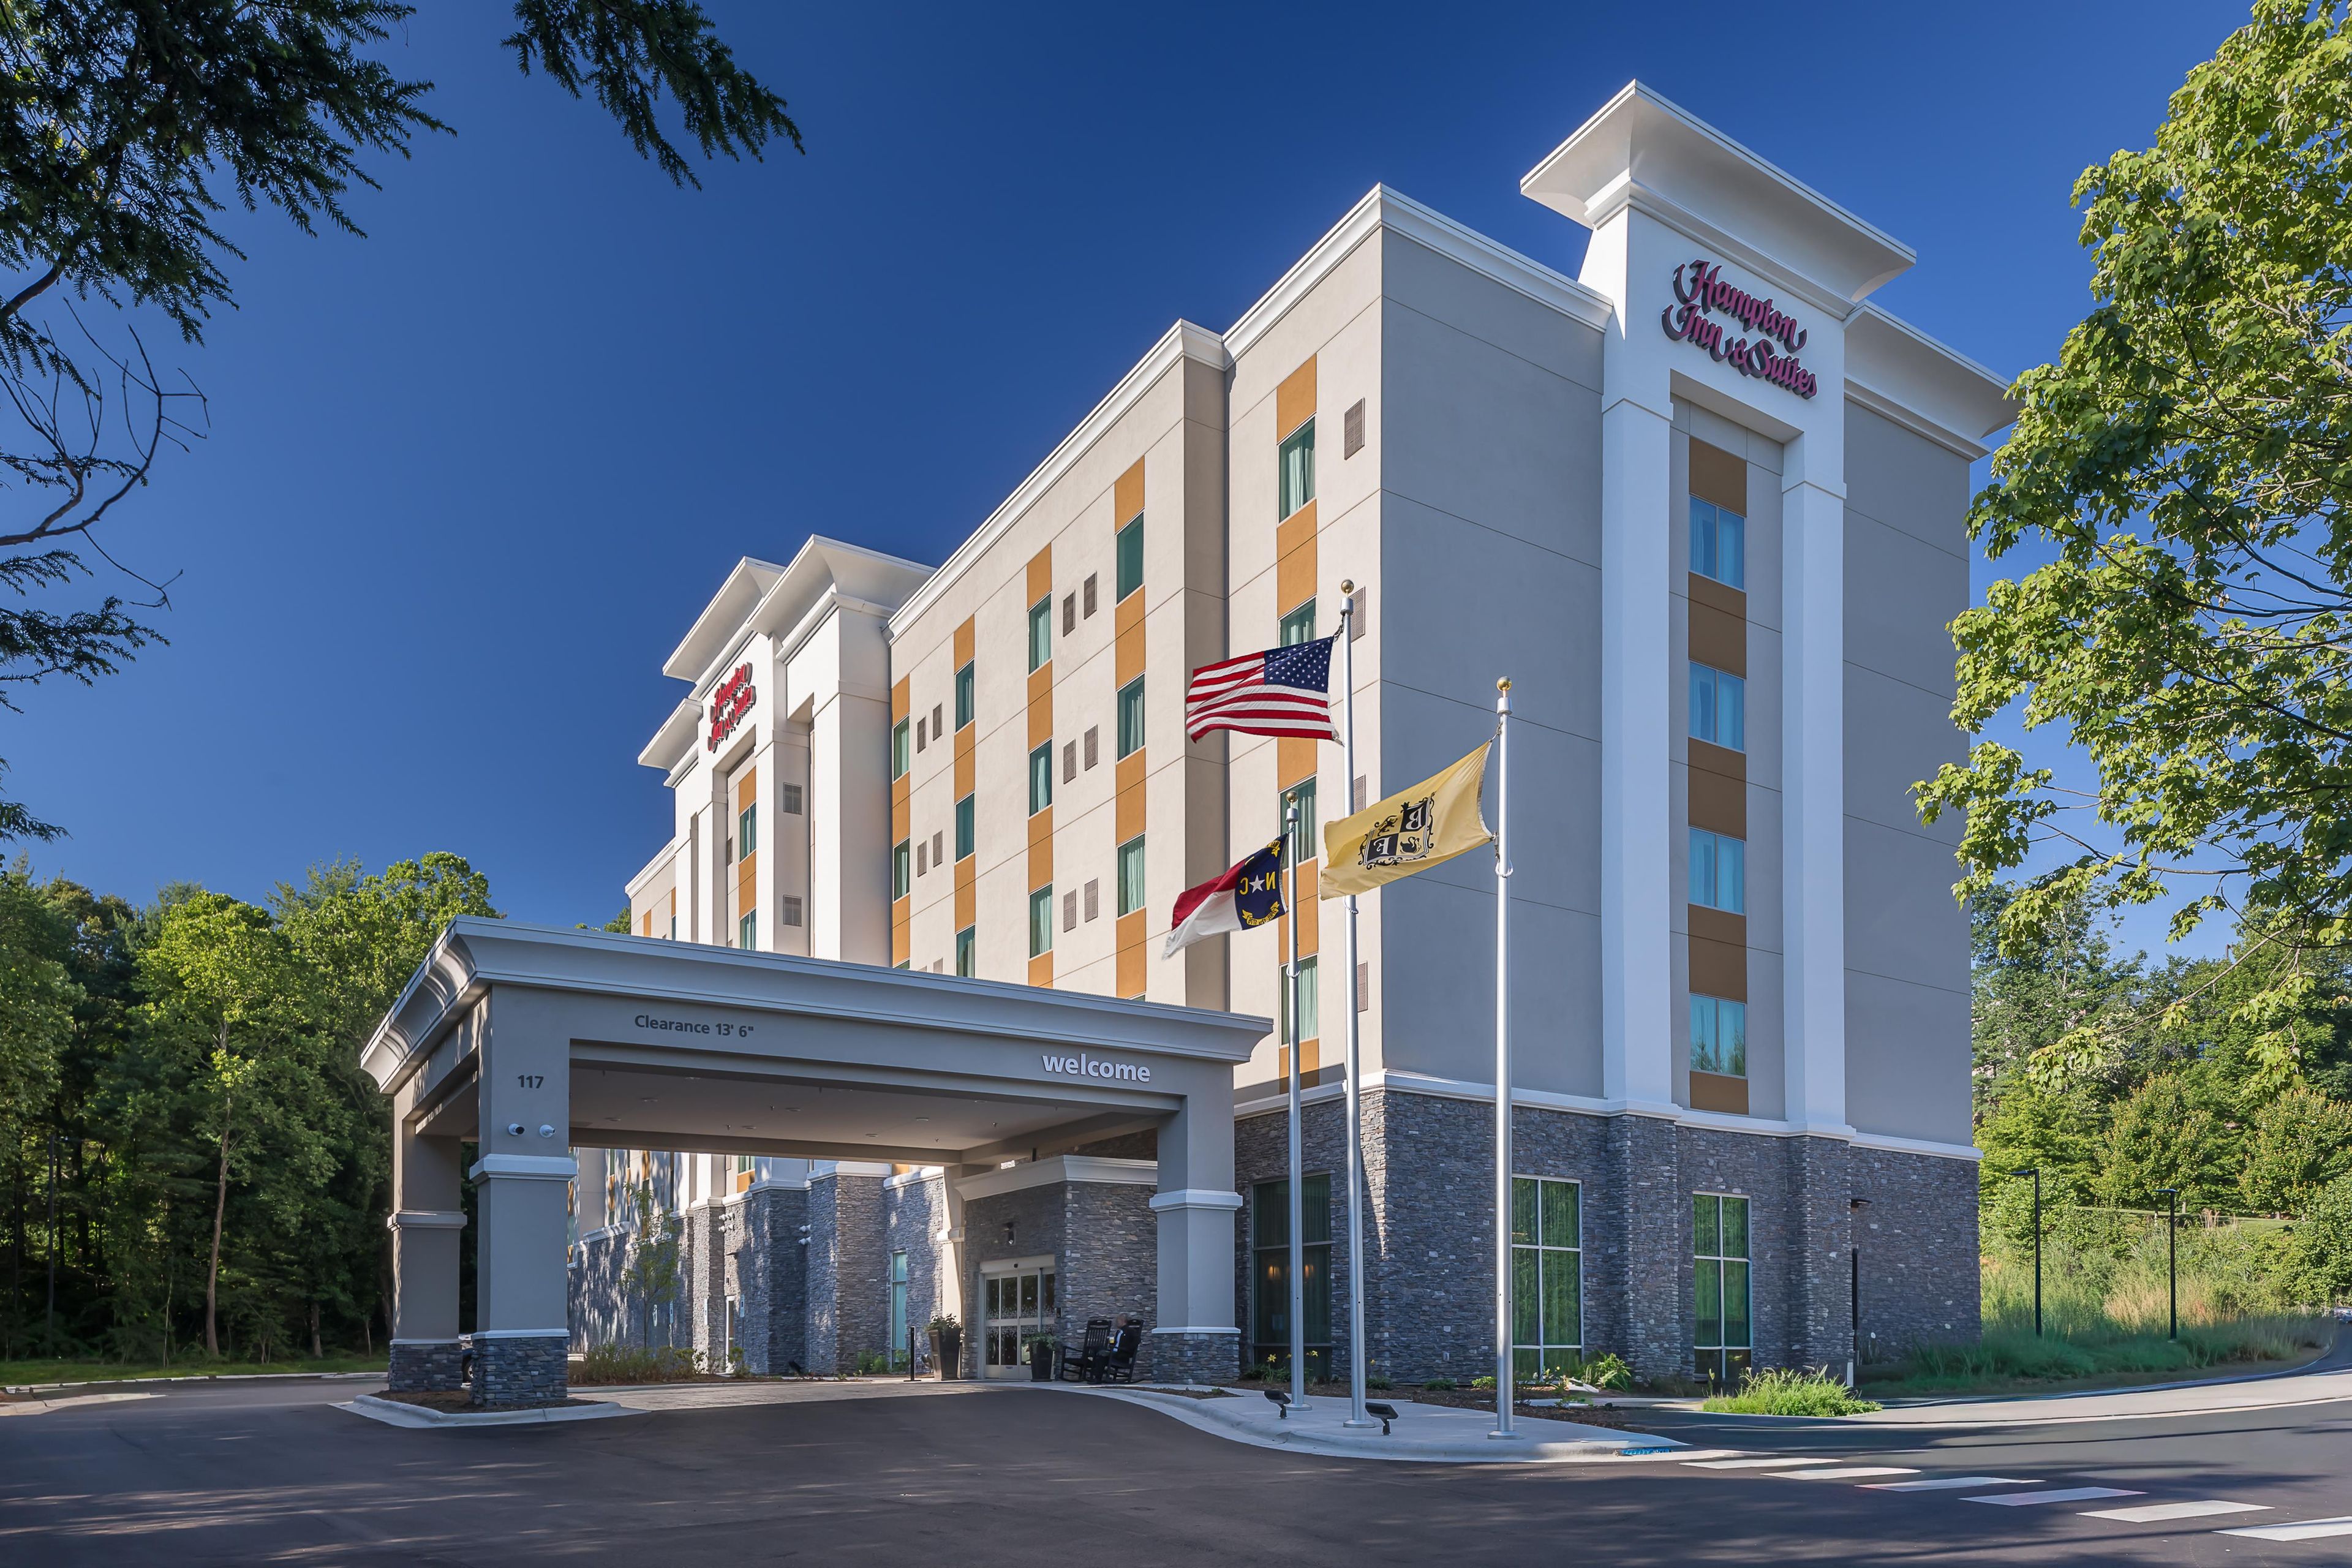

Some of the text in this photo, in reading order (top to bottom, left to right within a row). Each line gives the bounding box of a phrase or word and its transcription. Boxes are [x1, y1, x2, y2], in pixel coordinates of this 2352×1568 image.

[1673, 260, 1807, 353] Hampton
[1662, 303, 1817, 399] Inn & Suites
[710, 662, 753, 723] Hampton
[635, 1015, 754, 1038] Clearance 13' 6"
[518, 1075, 544, 1088] 117
[1042, 1053, 1150, 1082] welcome
